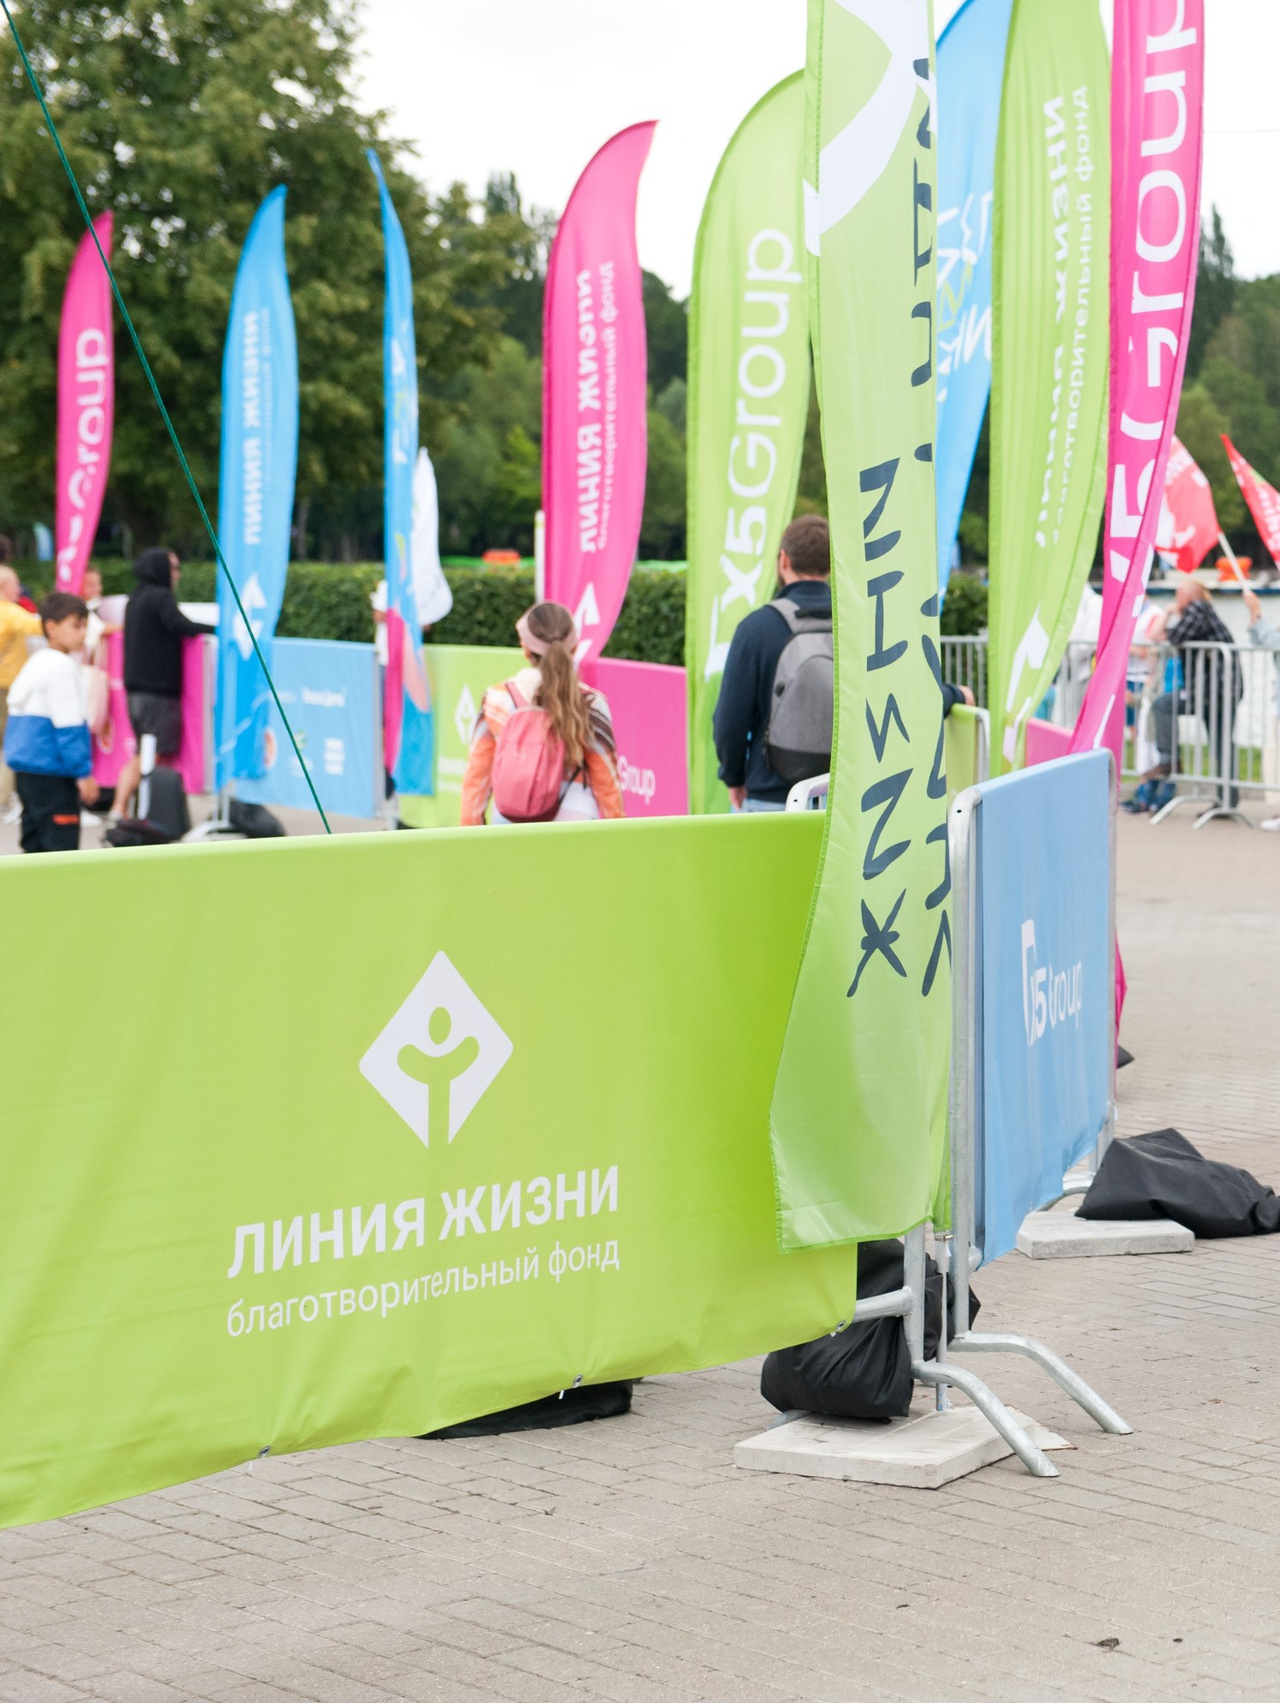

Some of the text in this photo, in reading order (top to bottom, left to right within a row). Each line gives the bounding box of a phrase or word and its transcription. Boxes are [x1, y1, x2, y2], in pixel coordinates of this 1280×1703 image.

[1072, 86, 1093, 181] фонд
[577, 424, 601, 552] ЛИНИЯ
[228, 1165, 619, 1279] ЛИНИЯ ЖИЗНИ
[227, 1240, 620, 1338] благотворительный фонд
